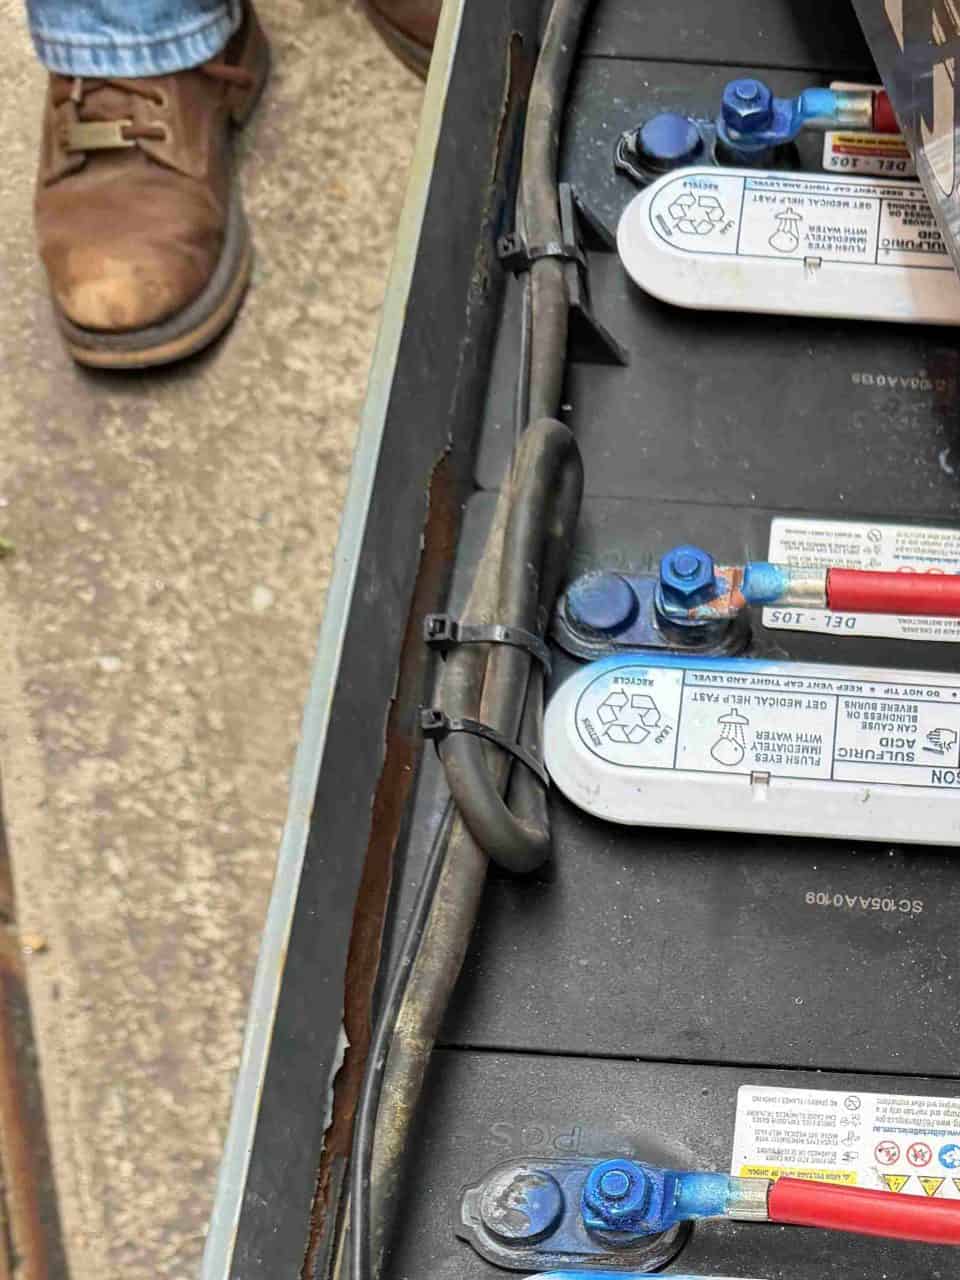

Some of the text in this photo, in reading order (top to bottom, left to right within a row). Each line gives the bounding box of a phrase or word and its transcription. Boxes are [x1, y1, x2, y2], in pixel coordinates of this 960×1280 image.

[769, 611, 857, 630] DEL 105
[612, 676, 655, 688] RECYCLE
[883, 687, 900, 696] TIP
[902, 687, 924, 697] NOT
[691, 692, 828, 710] GET MEDICAL HELP FAST
[843, 700, 919, 713] SEVERE BURNS
[863, 712, 918, 723] BLINDNESS
[861, 721, 918, 733] CAN CAUSE
[654, 724, 673, 745] LEAD
[755, 730, 822, 745] WITH WATER
[750, 741, 822, 755] IMMEDIATELY
[879, 737, 916, 749] ACID
[754, 753, 821, 767] FLUSH EYES
[837, 747, 915, 762] SULFURIC
[805, 892, 925, 913] SC105AA0109
